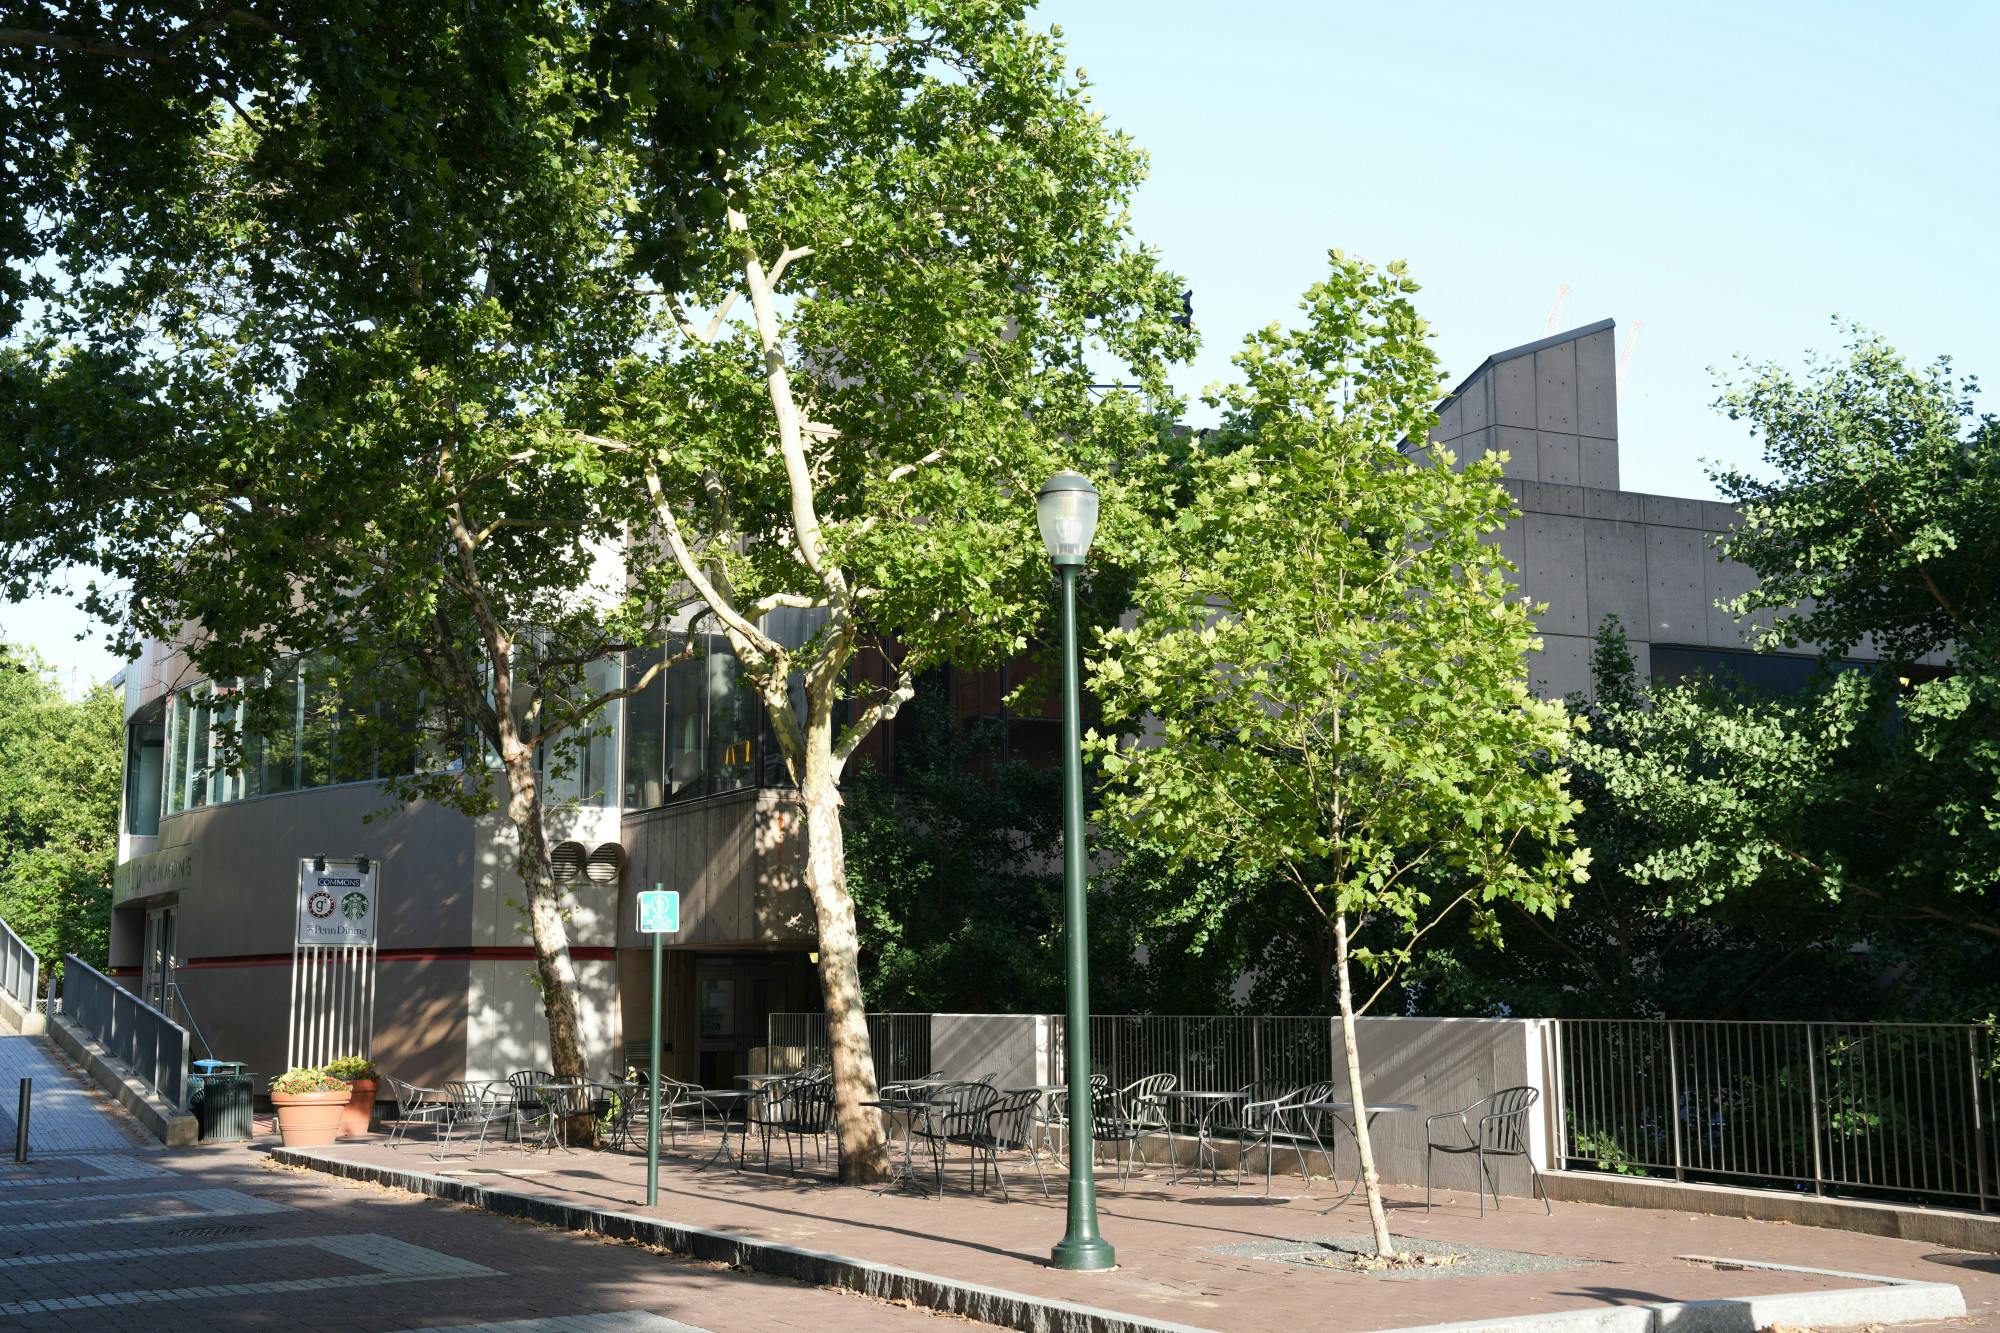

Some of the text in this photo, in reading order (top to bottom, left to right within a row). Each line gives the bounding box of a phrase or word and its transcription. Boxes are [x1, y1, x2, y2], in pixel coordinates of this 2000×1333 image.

[147, 856, 192, 884] COMMONS
[318, 879, 360, 887] COMMONS
[315, 925, 367, 938] Penn Dining
